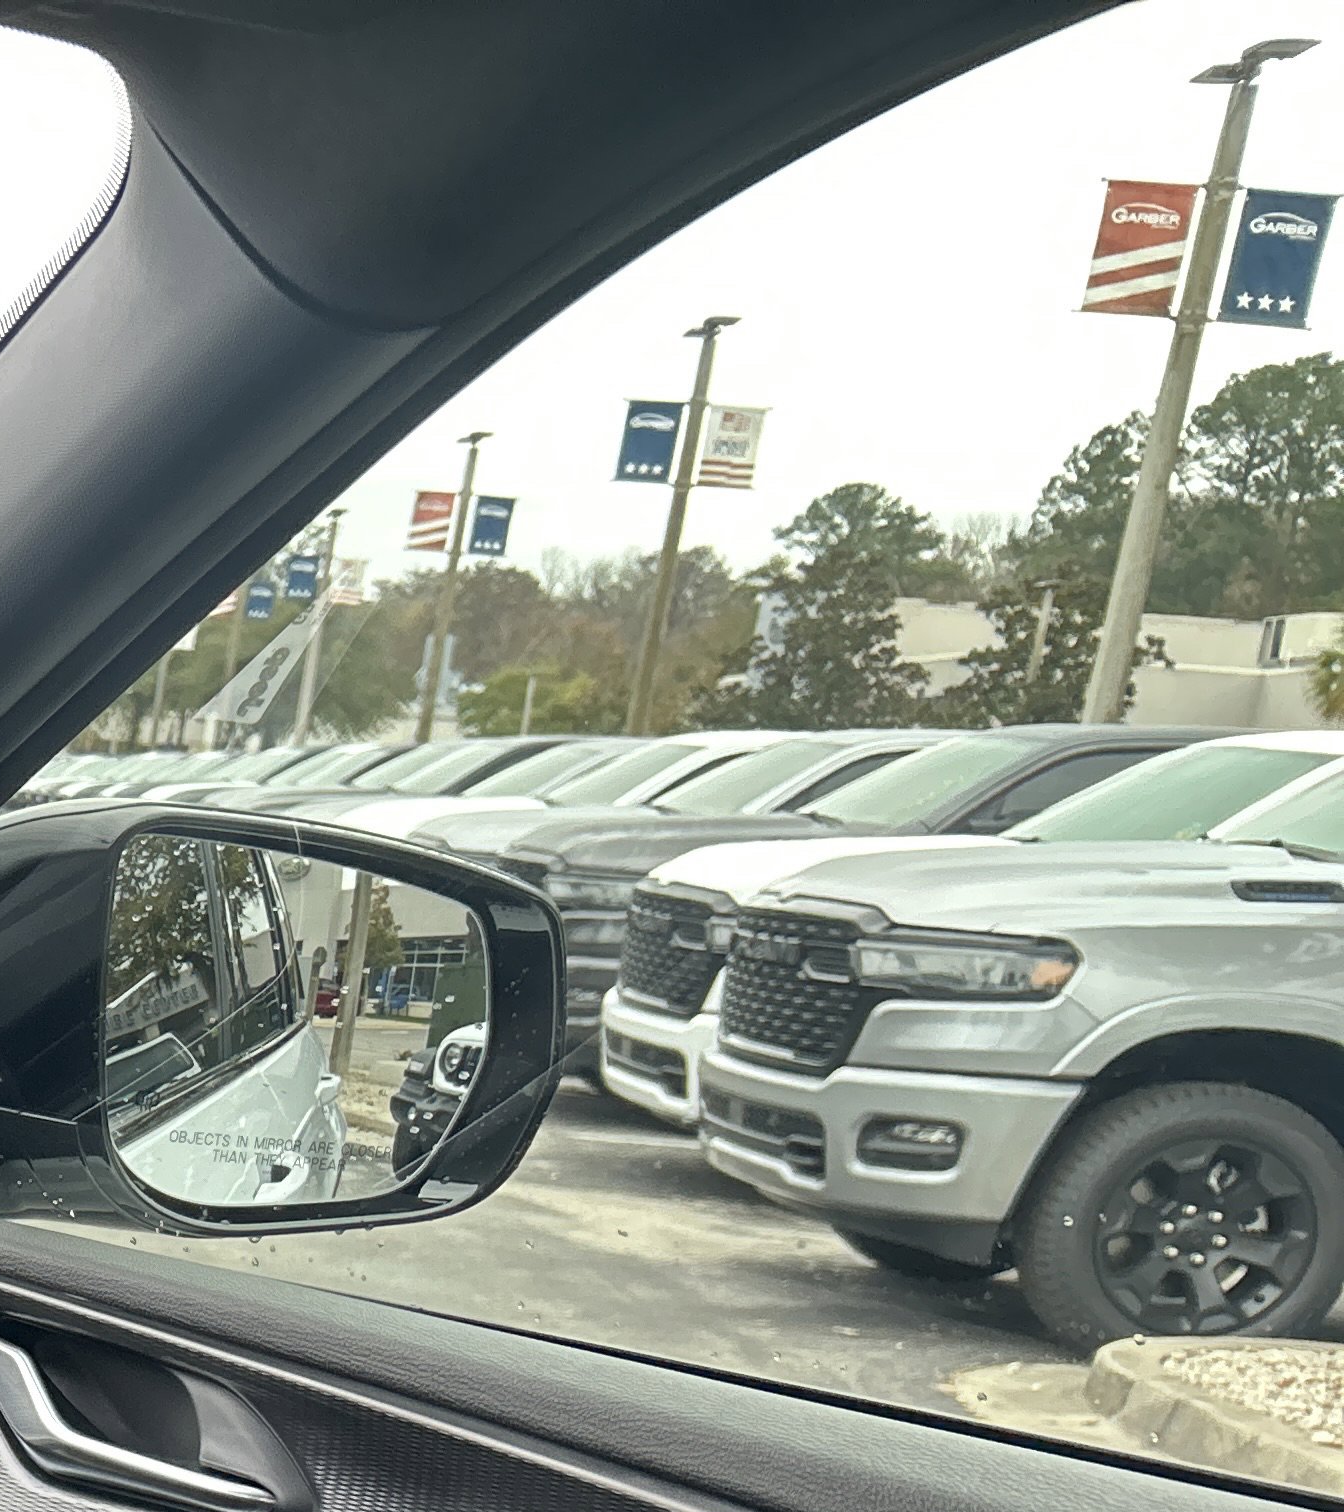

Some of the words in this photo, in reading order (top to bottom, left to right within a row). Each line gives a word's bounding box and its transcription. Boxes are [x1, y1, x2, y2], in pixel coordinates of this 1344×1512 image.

[1111, 206, 1181, 226] GARBER
[1249, 217, 1318, 238] GARBER
[168, 1129, 231, 1148] OBJECTS
[235, 1134, 249, 1148] IN
[253, 1136, 302, 1153] MIRROR
[307, 1141, 335, 1156] ARE
[340, 1144, 392, 1160] CLOSER
[212, 1148, 248, 1165] THAN
[255, 1152, 286, 1167] THEY
[291, 1155, 346, 1172] APPEAR
